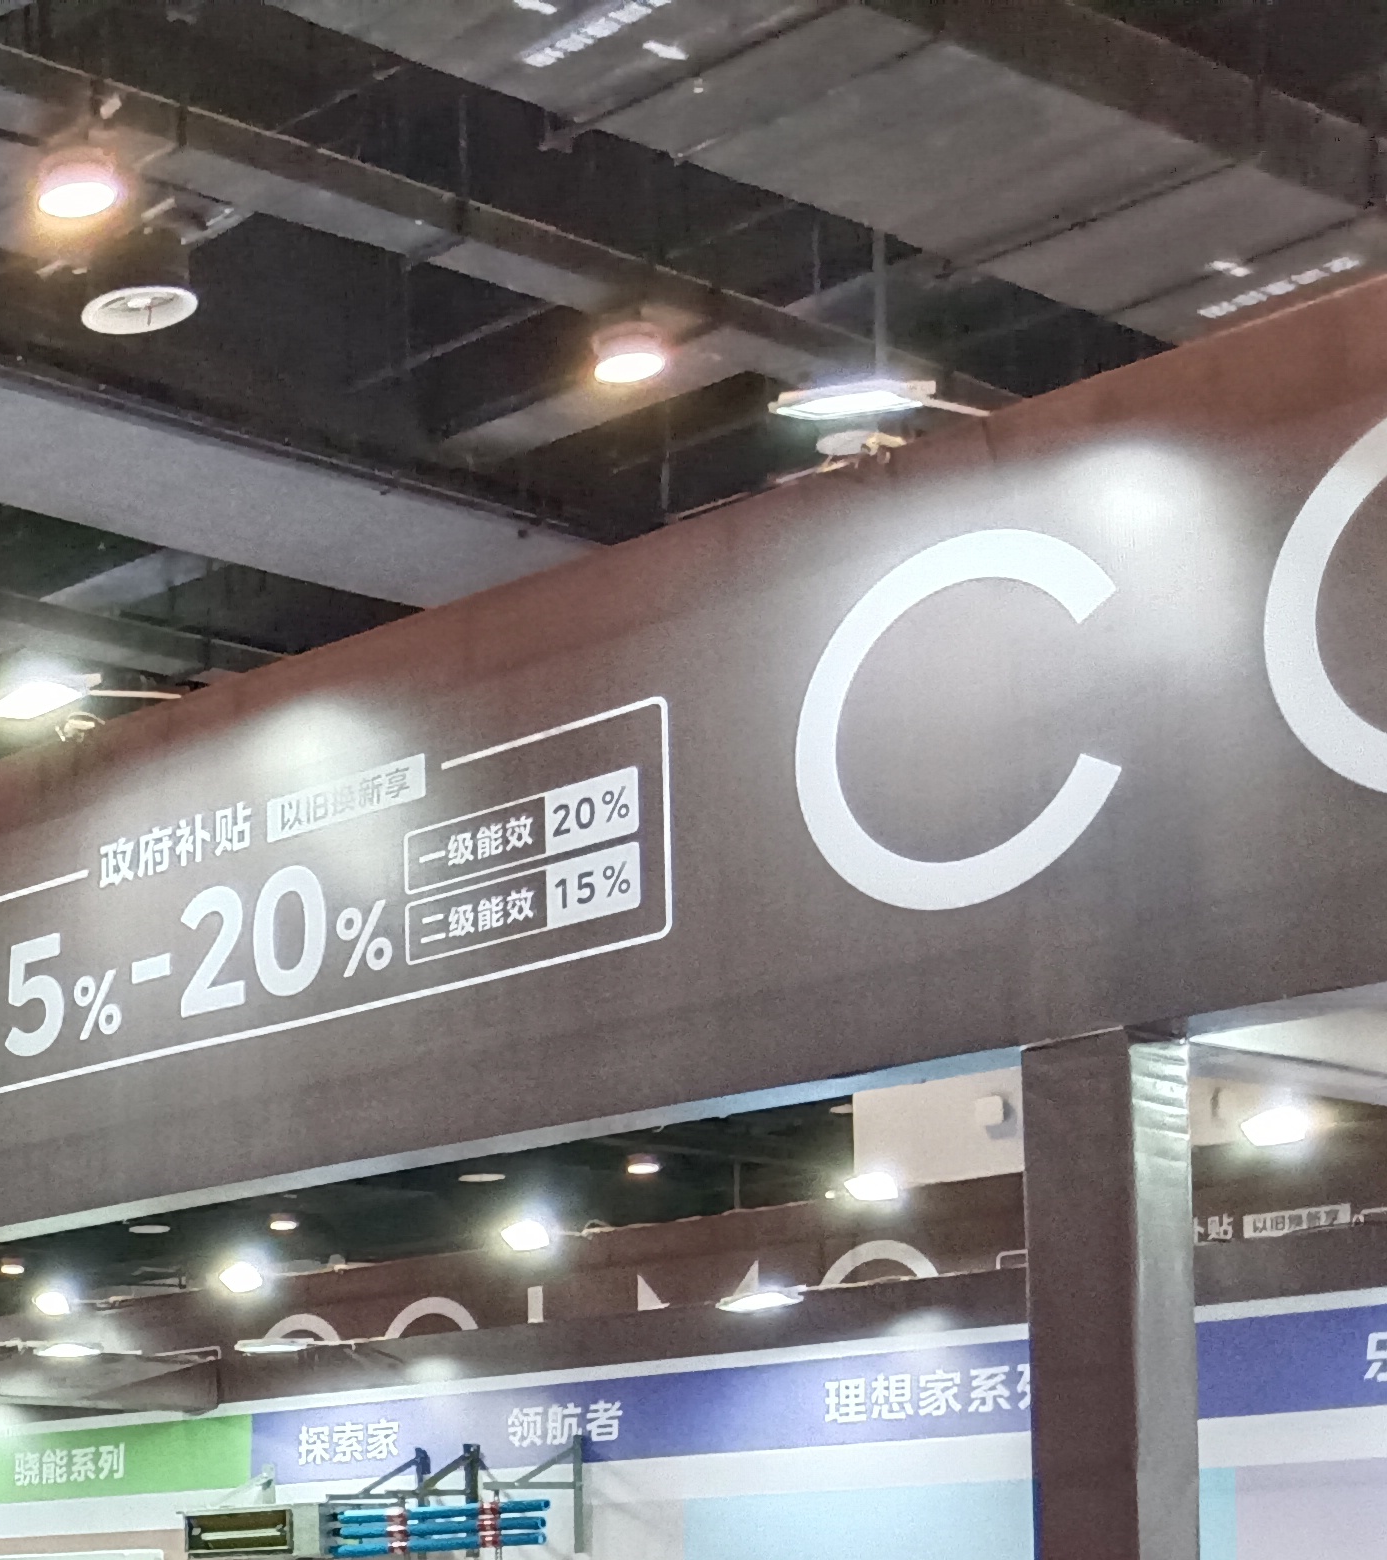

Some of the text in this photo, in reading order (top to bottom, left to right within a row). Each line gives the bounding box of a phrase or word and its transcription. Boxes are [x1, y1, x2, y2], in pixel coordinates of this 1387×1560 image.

[98, 803, 253, 888] 政府补贴
[418, 783, 631, 868] 一级能效 20%
[420, 862, 632, 942] 二级能效 15%
[507, 1400, 624, 1448] 领航者
[824, 1364, 1031, 1424] 理想家系
[298, 1417, 401, 1466] 探索家
